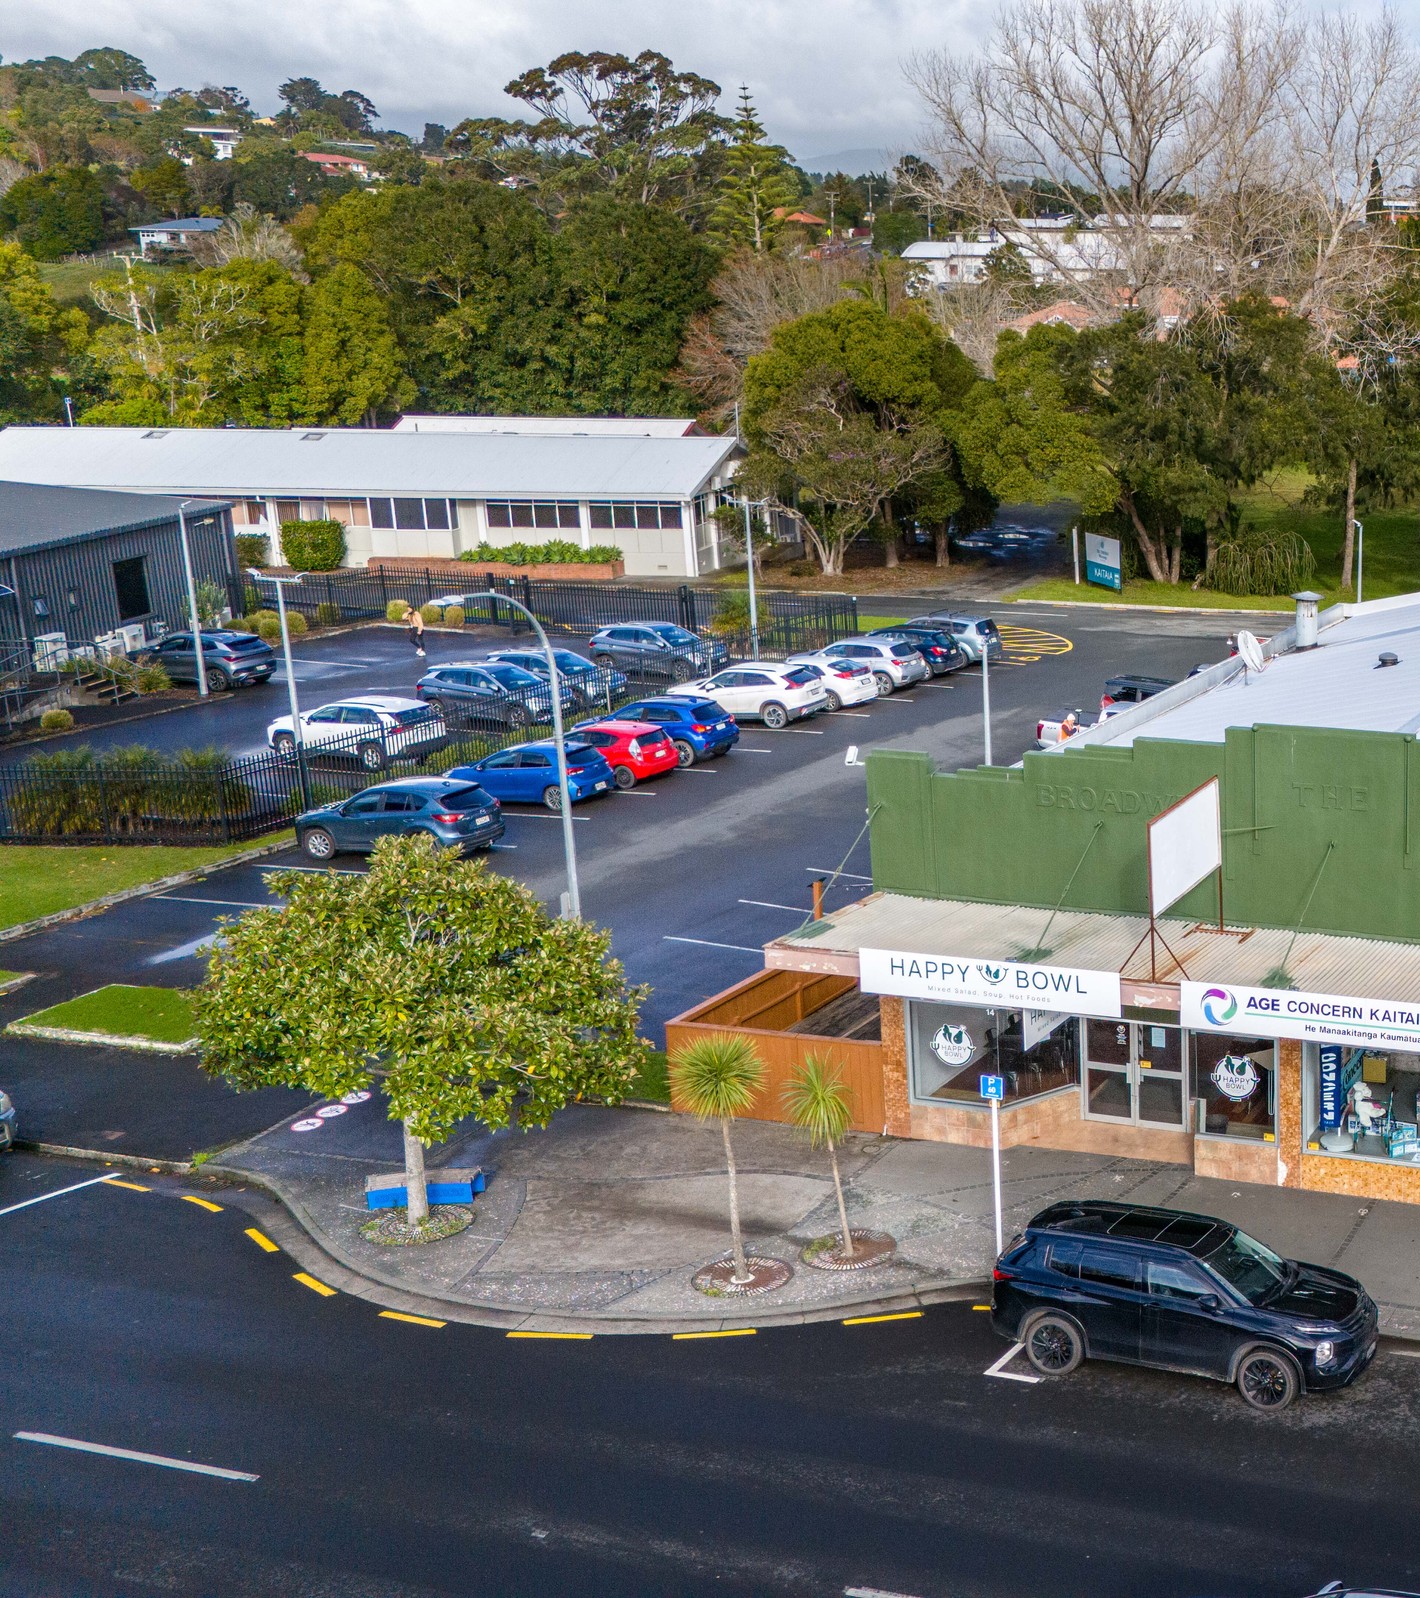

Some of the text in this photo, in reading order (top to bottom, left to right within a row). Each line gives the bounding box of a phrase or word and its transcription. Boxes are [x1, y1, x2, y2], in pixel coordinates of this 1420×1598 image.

[1036, 784, 1187, 816] BROADW
[1292, 782, 1368, 812] THE
[890, 957, 1088, 994] HAPPY BOWL
[927, 985, 951, 993] Mixed
[1027, 995, 1051, 1003] Foods
[1246, 996, 1280, 1011] AGE
[1287, 1000, 1363, 1020] CONCERN
[1305, 1024, 1316, 1033] He
[1319, 1026, 1378, 1041] Manaakitanga
[941, 1044, 967, 1055] HAPPY
[944, 1051, 963, 1059] BOWL
[988, 1078, 995, 1086] P
[1223, 1076, 1250, 1085] HAPPY
